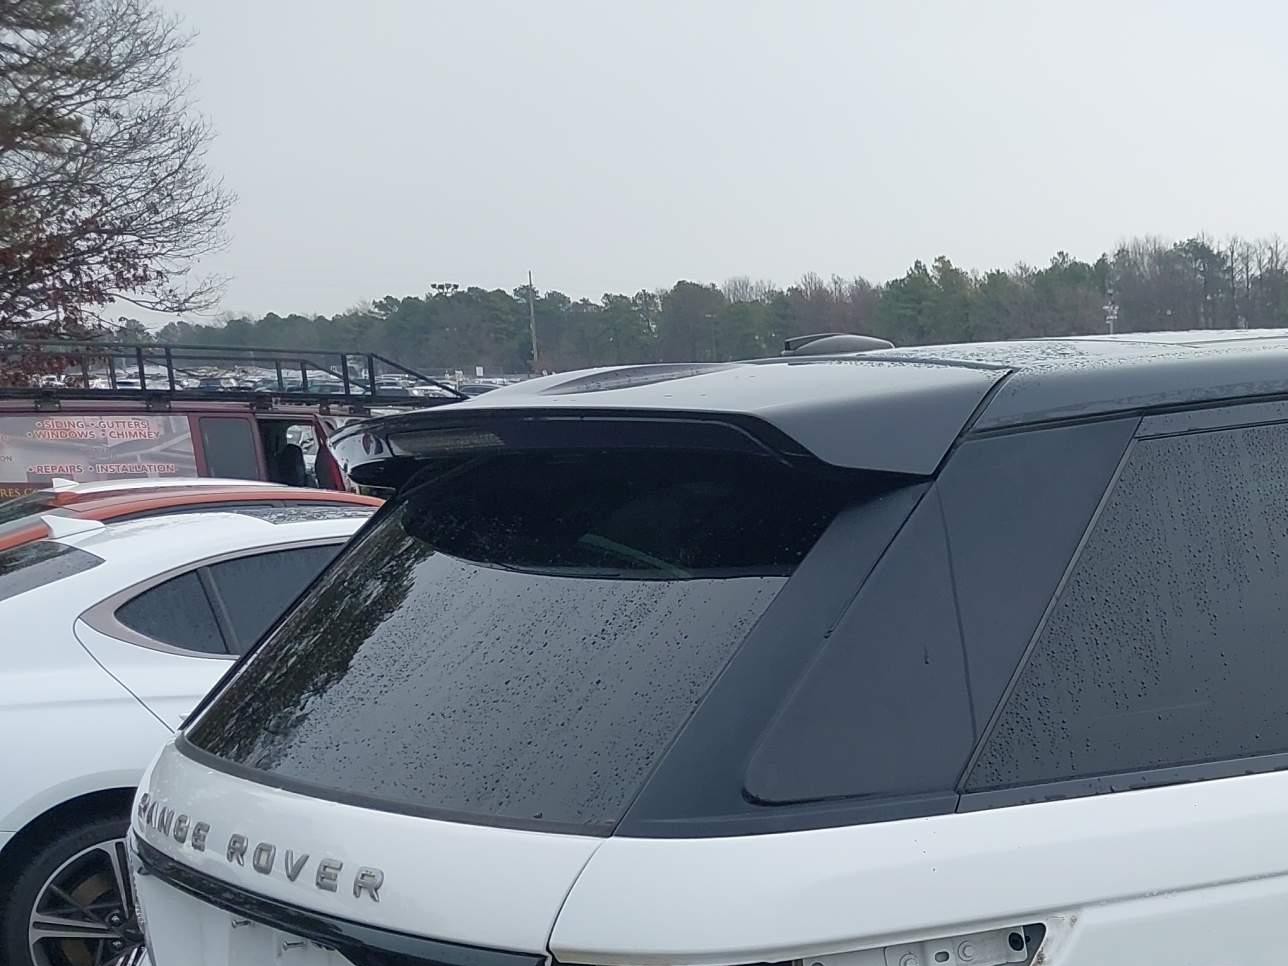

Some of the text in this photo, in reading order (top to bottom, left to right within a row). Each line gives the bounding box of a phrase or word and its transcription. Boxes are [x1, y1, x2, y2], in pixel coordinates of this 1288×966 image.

[44, 420, 149, 429] SIDING GUTTERS
[33, 430, 160, 439] WINDOWS CHIMNEY
[36, 463, 176, 474] REPAIRS INSTALLATION
[138, 792, 385, 903] RANGE ROVER
